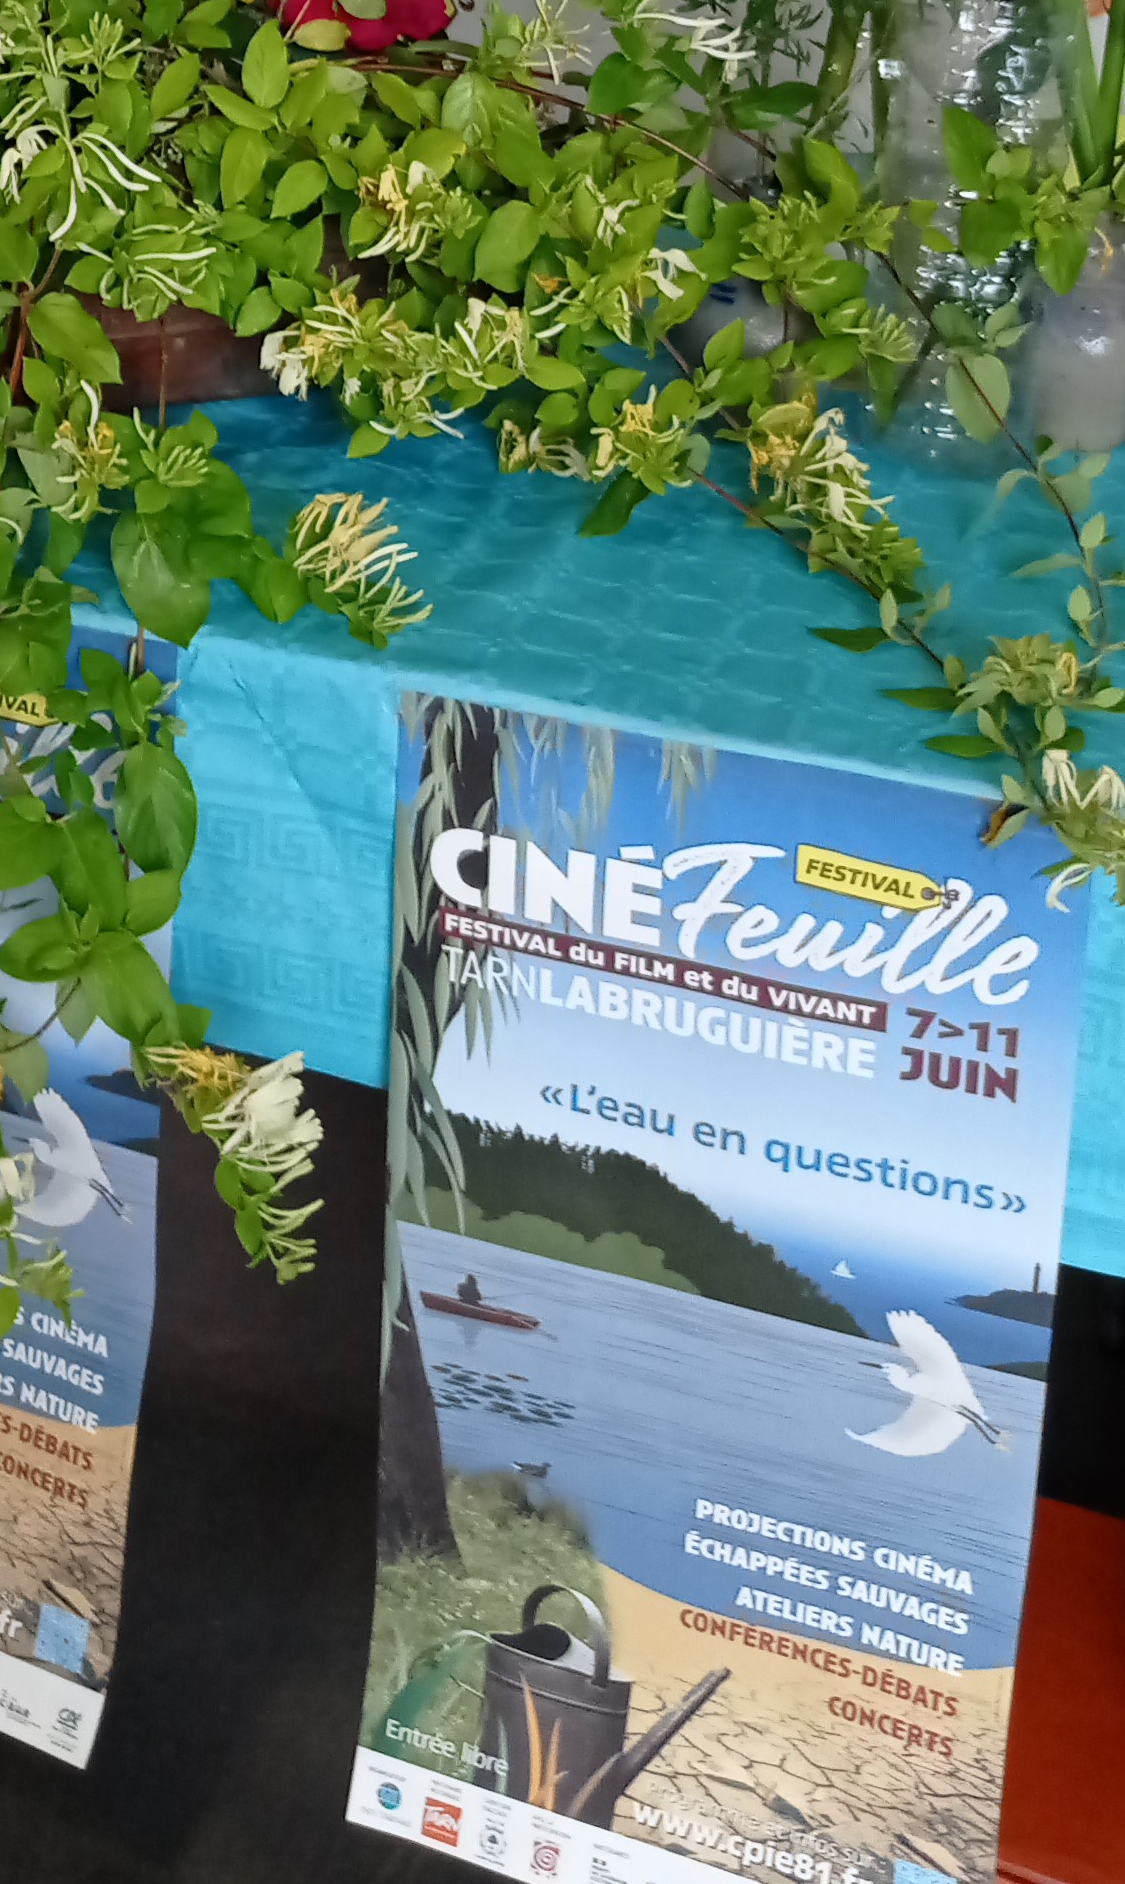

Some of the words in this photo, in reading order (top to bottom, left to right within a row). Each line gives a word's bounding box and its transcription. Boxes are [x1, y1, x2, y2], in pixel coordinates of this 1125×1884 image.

[805, 857, 915, 900] FESTIVAL
[443, 912, 563, 957] FESTIVAL
[569, 941, 605, 967] du
[614, 952, 675, 981] FILM
[683, 969, 714, 991] et
[721, 975, 759, 1001] du
[767, 985, 878, 1025] VIVANT
[899, 1045, 1020, 1104] JUIN
[692, 1120, 747, 1156] en
[763, 1137, 1028, 1214] questions»
[31, 1311, 109, 1359] CINÉMA
[2, 1338, 105, 1397] SAUVAGES
[20, 1381, 100, 1435] NATURE
[694, 1497, 867, 1562] PROJECTIONS
[873, 1546, 974, 1596] CINÉMA
[684, 1530, 831, 1591] ÉCHAPPÉES
[836, 1574, 970, 1635] SAUVAGES
[735, 1585, 854, 1638] ATELIERS
[861, 1621, 966, 1678] NATURE
[385, 1717, 457, 1759] Entrée
[461, 1740, 509, 1777] libre
[828, 1695, 955, 1758] CONCERTS
